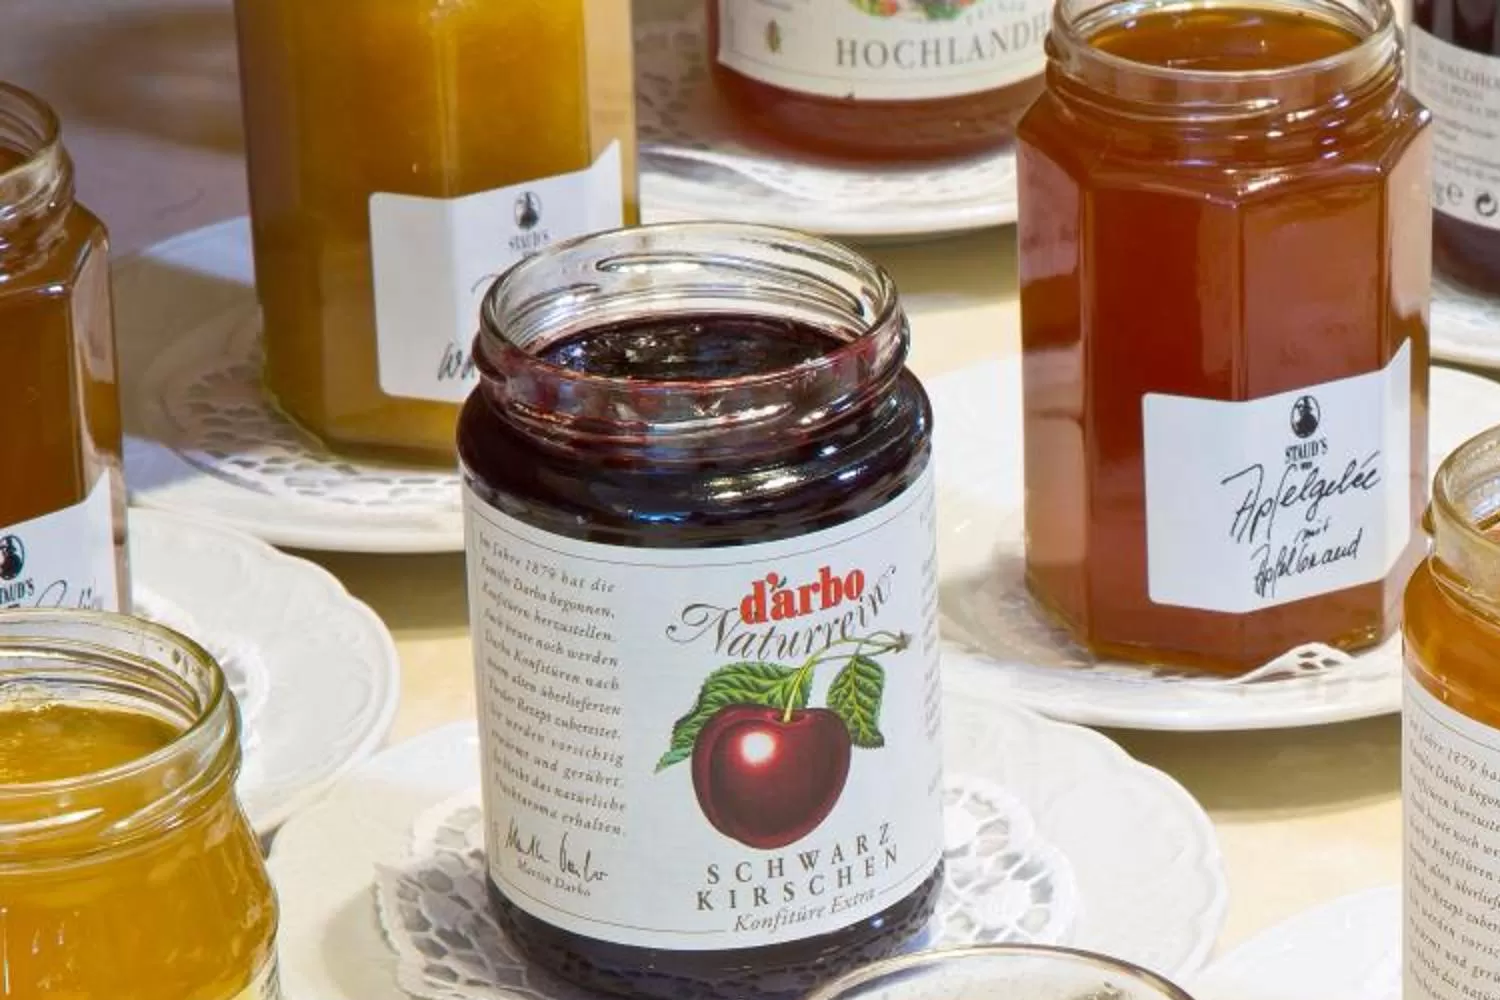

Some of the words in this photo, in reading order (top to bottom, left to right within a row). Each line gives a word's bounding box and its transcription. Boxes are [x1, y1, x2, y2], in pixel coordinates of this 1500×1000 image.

[1285, 438, 1328, 464] STAUD'S
[707, 822, 890, 885] SCHWARZ
[696, 844, 898, 911] KIRSCHEN
[829, 889, 876, 915] Extra
